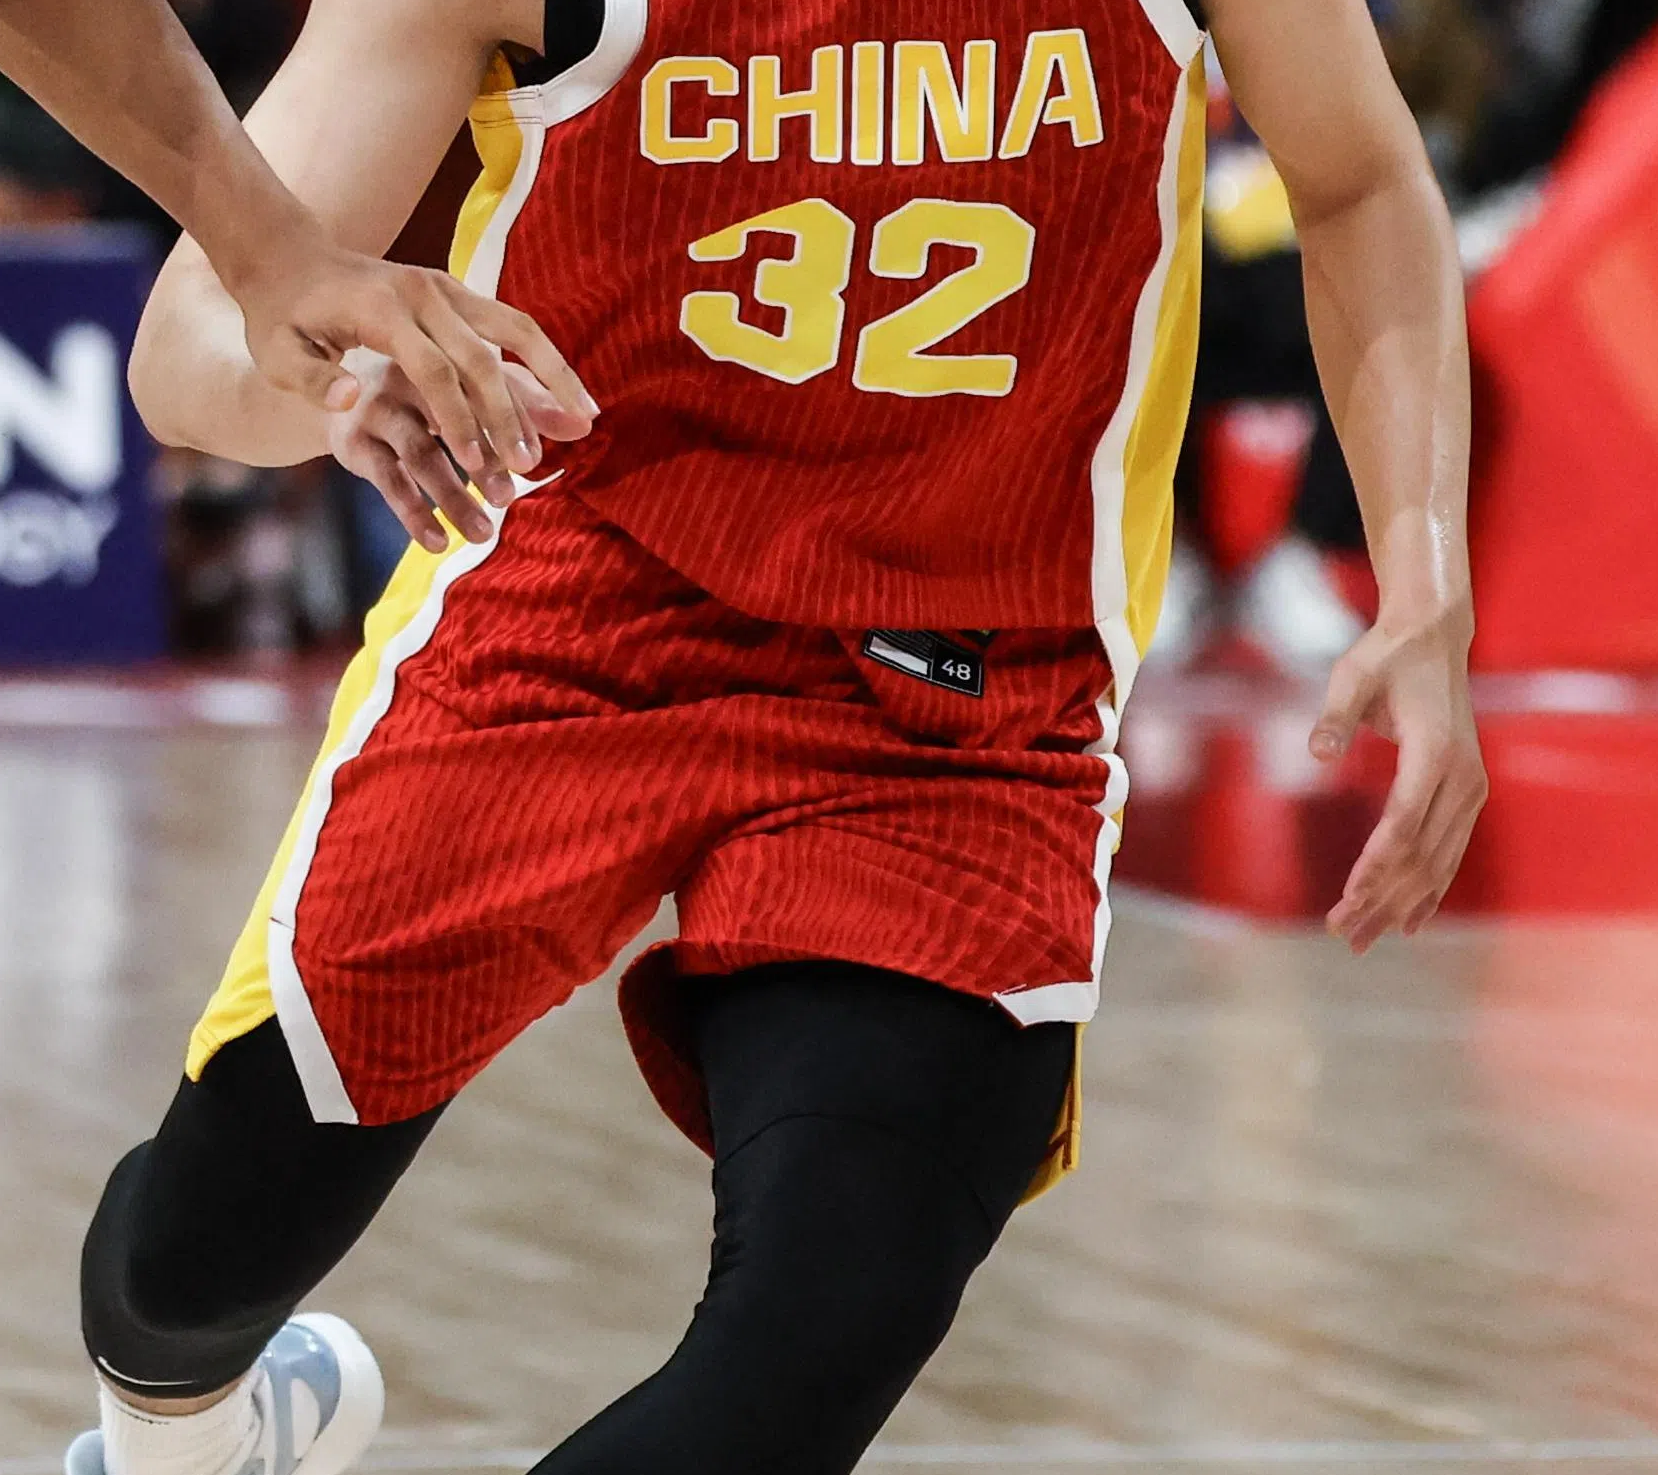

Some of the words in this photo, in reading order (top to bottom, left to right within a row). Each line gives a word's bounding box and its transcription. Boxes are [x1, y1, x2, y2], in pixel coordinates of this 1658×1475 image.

[640, 28, 1104, 165] CHINA
[679, 197, 1036, 397] 32
[941, 659, 972, 681] 48
